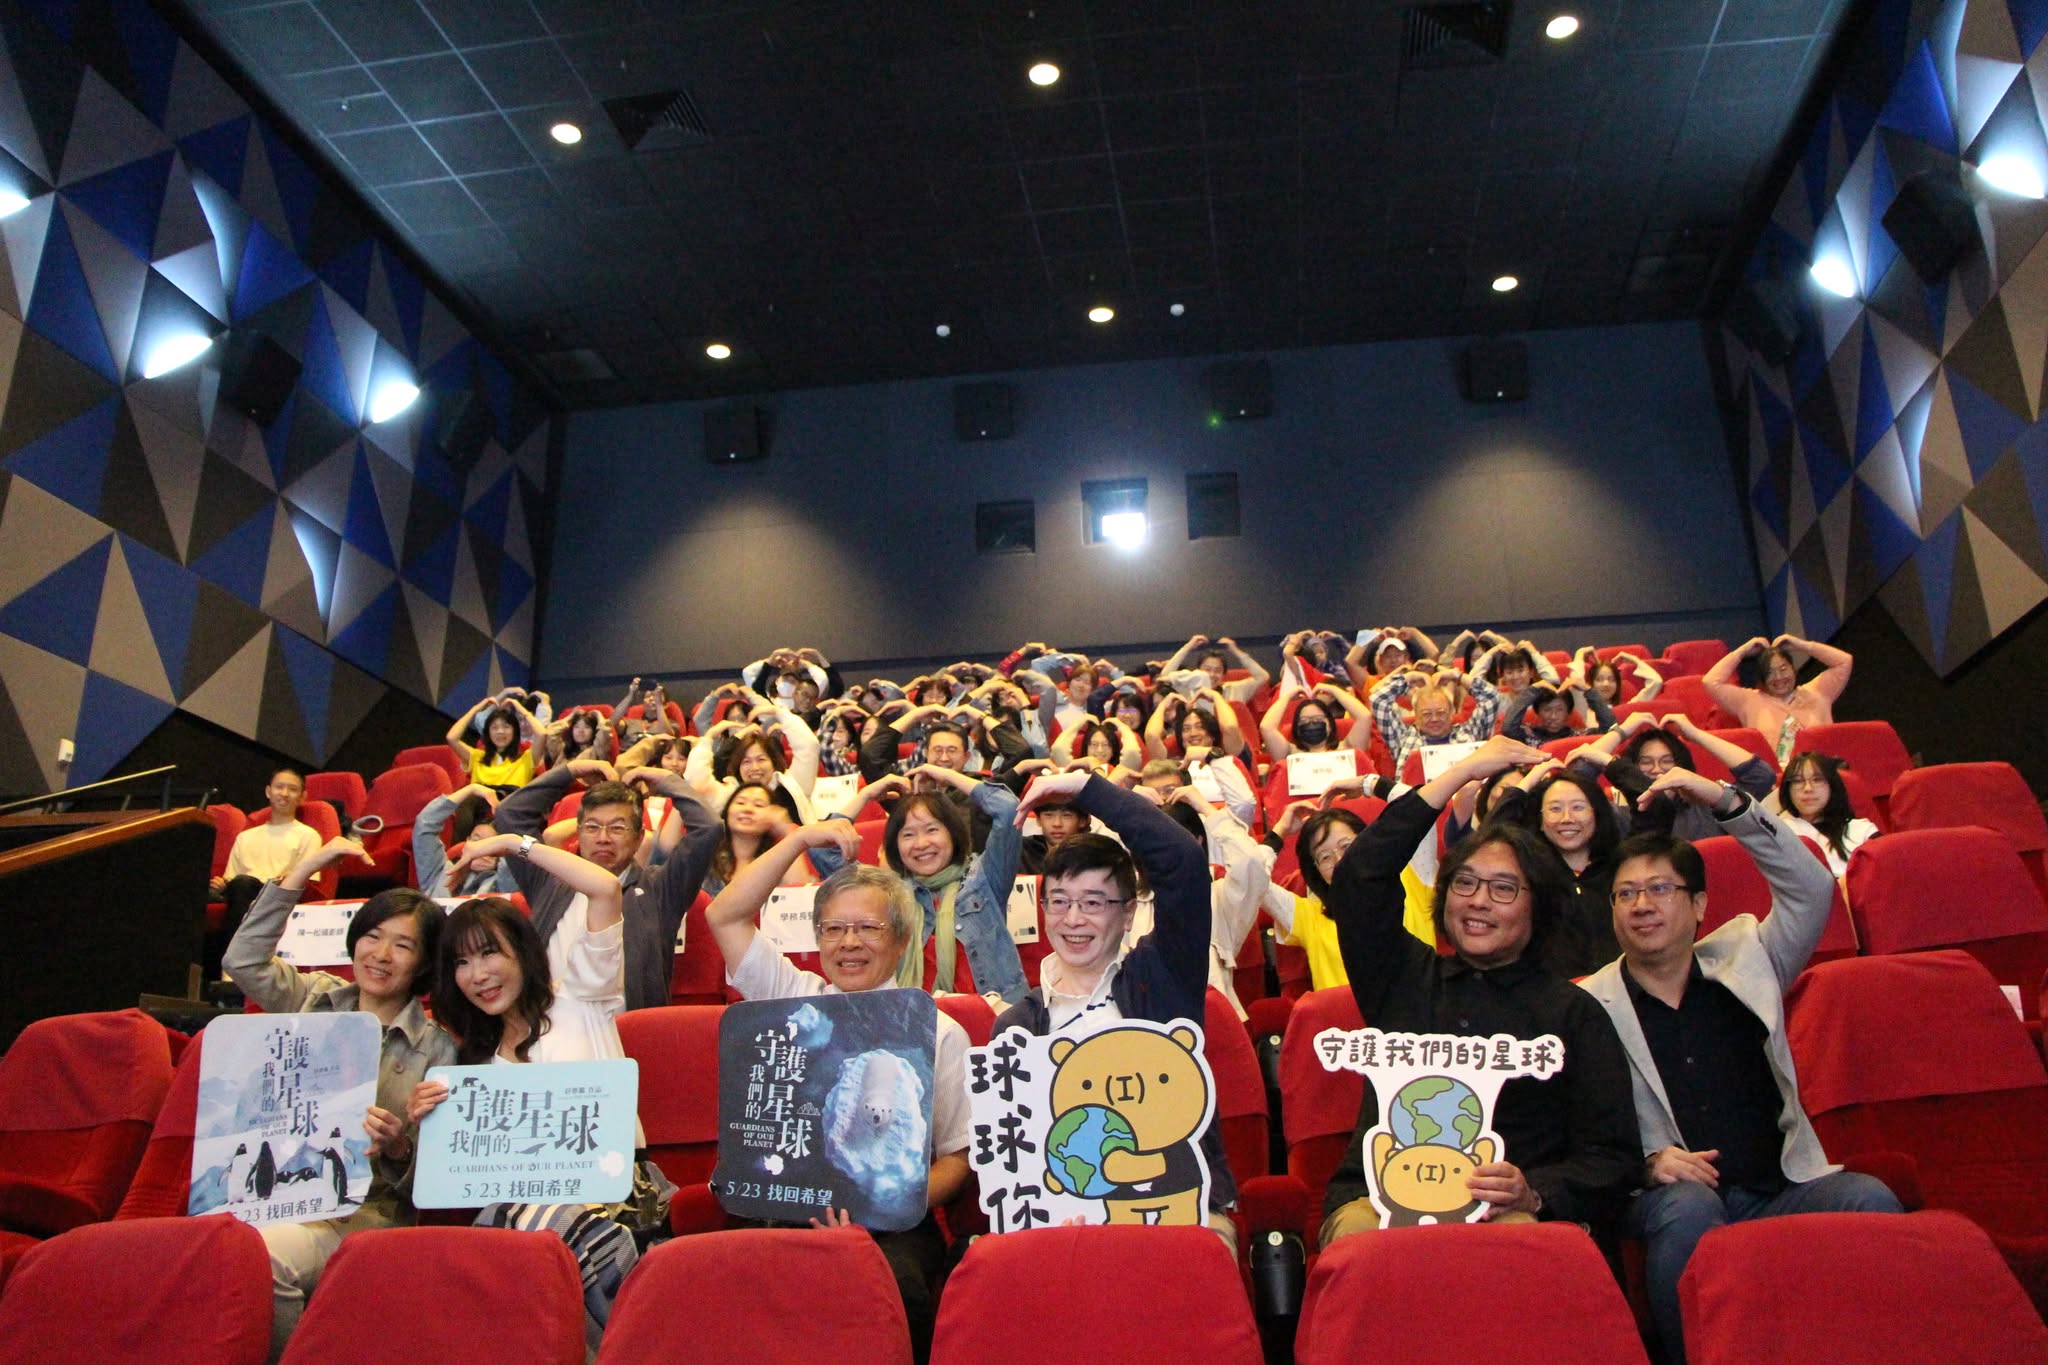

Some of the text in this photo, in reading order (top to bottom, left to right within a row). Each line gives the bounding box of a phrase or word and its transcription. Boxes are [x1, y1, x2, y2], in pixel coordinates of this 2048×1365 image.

[1320, 1033, 1556, 1072] 守護我們的星球
[745, 1064, 765, 1120] 我們的
[729, 1122, 776, 1133] GUARDIANS
[449, 1130, 511, 1157] 我們的
[743, 1139, 774, 1149] PLANET
[449, 1163, 508, 1174] GUARDIANS
[511, 1163, 524, 1172] OF
[555, 1160, 594, 1170] PLANET
[462, 1178, 581, 1199] 5/23 找回希望
[726, 1181, 833, 1207] 5/23 找回希望
[267, 1197, 323, 1220] 找回希望
